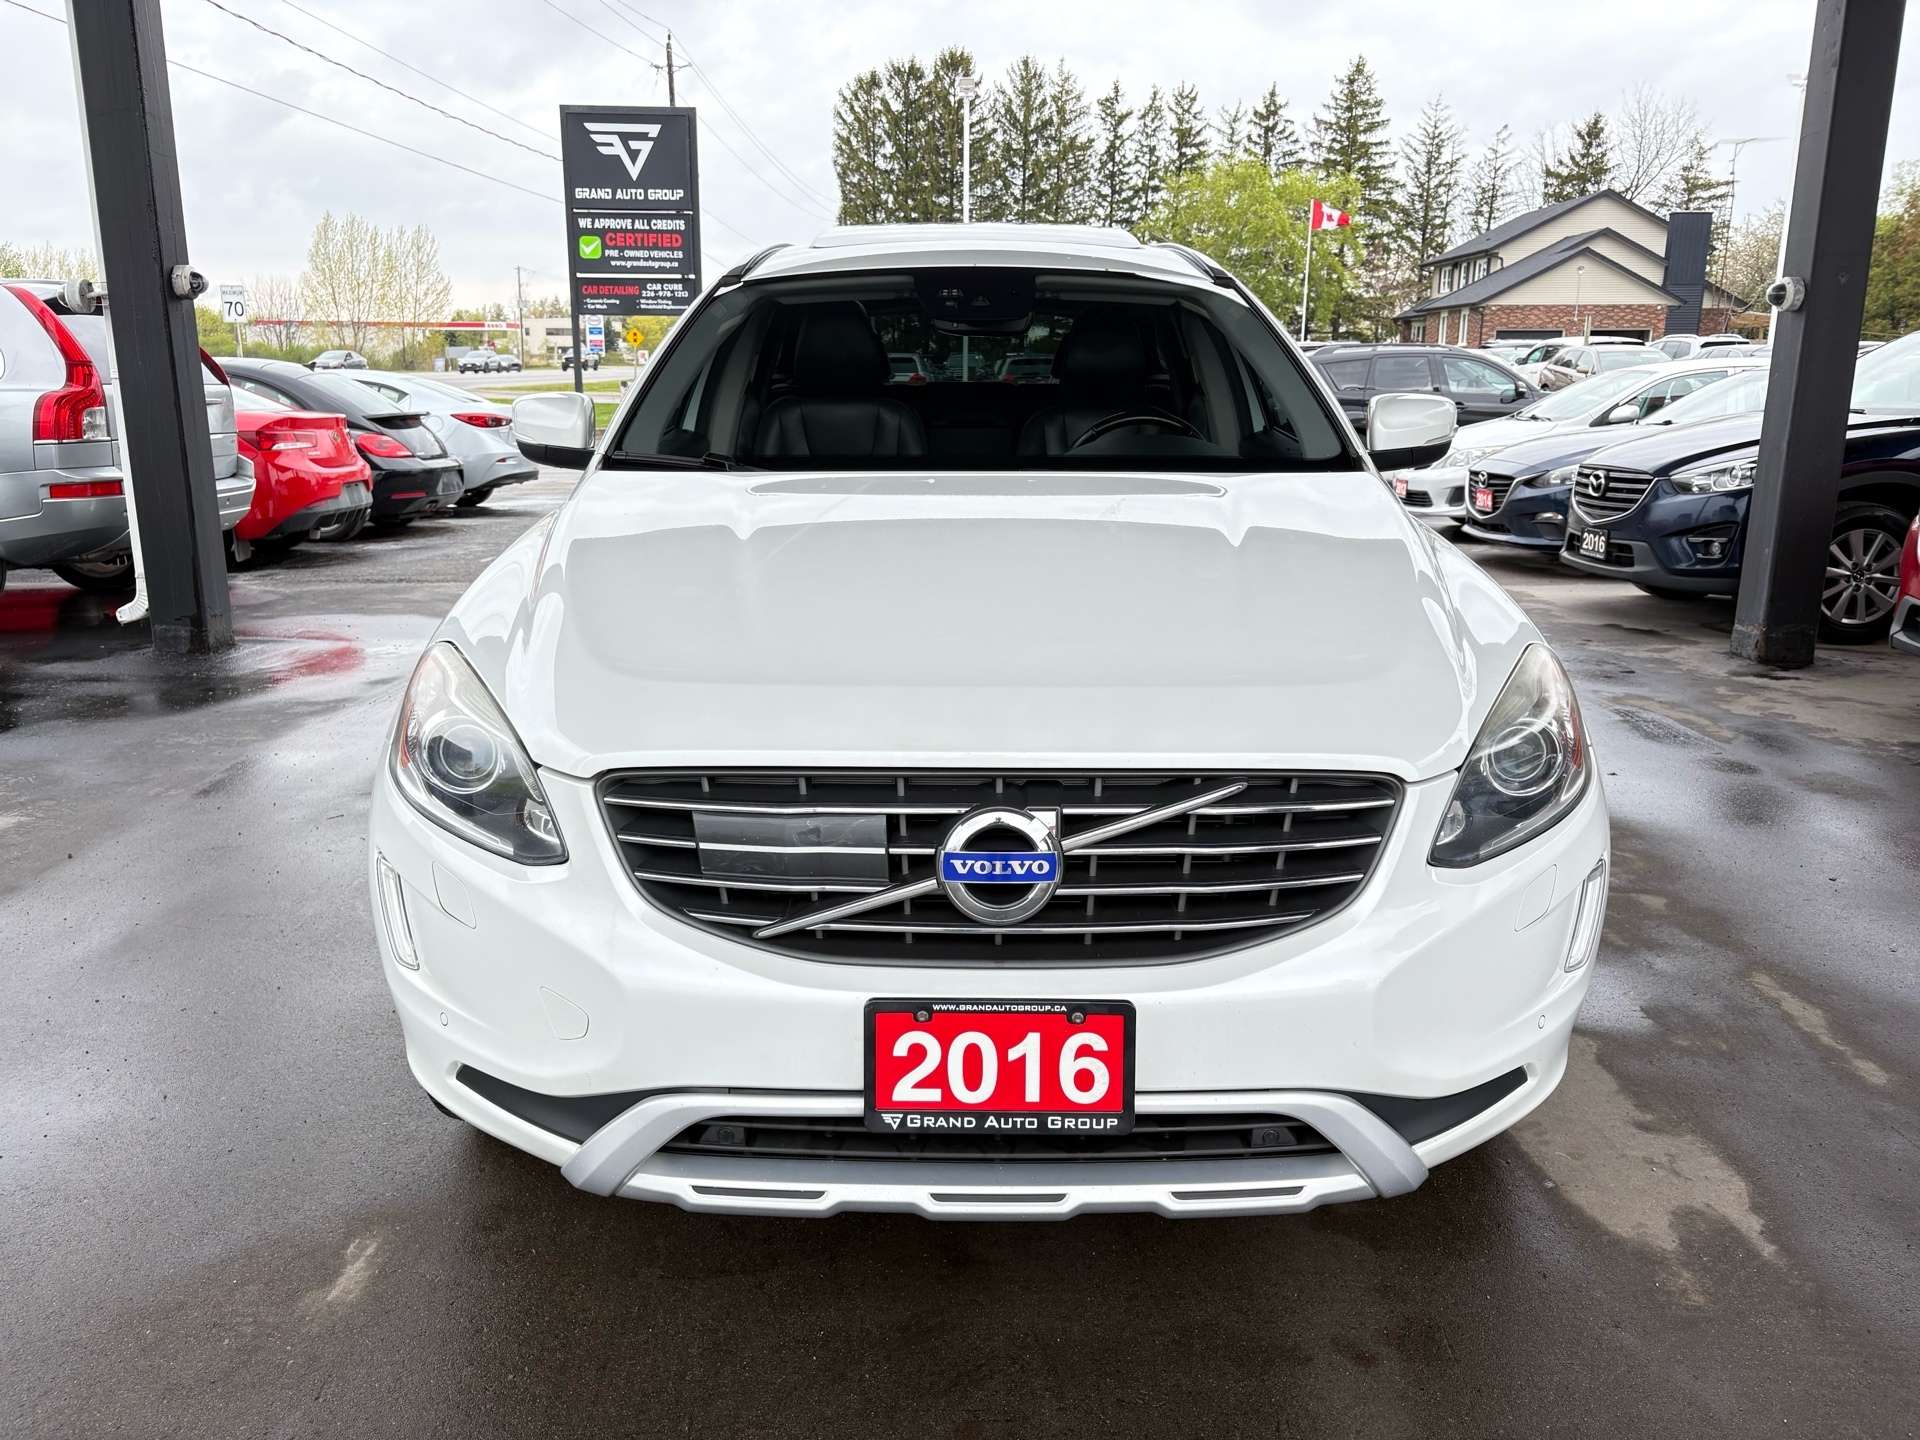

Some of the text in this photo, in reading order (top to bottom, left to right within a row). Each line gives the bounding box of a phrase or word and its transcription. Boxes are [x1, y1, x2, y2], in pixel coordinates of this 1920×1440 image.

[575, 188, 684, 200] GRAND AUTO GROUP
[578, 218, 686, 230] WE APPROVE ALL CREDITS
[605, 232, 682, 247] CERTIFIED
[624, 250, 649, 258] OWNED
[650, 250, 683, 258] VEHICLES
[582, 286, 640, 295] CAR DETAILING
[647, 283, 683, 291] CAR CURE
[223, 301, 244, 317] 70
[1582, 532, 1606, 552] 2016
[950, 860, 1050, 875] VOLVO
[933, 1004, 1067, 1012] WWW.GRANDAUTOGROUP.CA
[892, 1030, 1110, 1105] 2016
